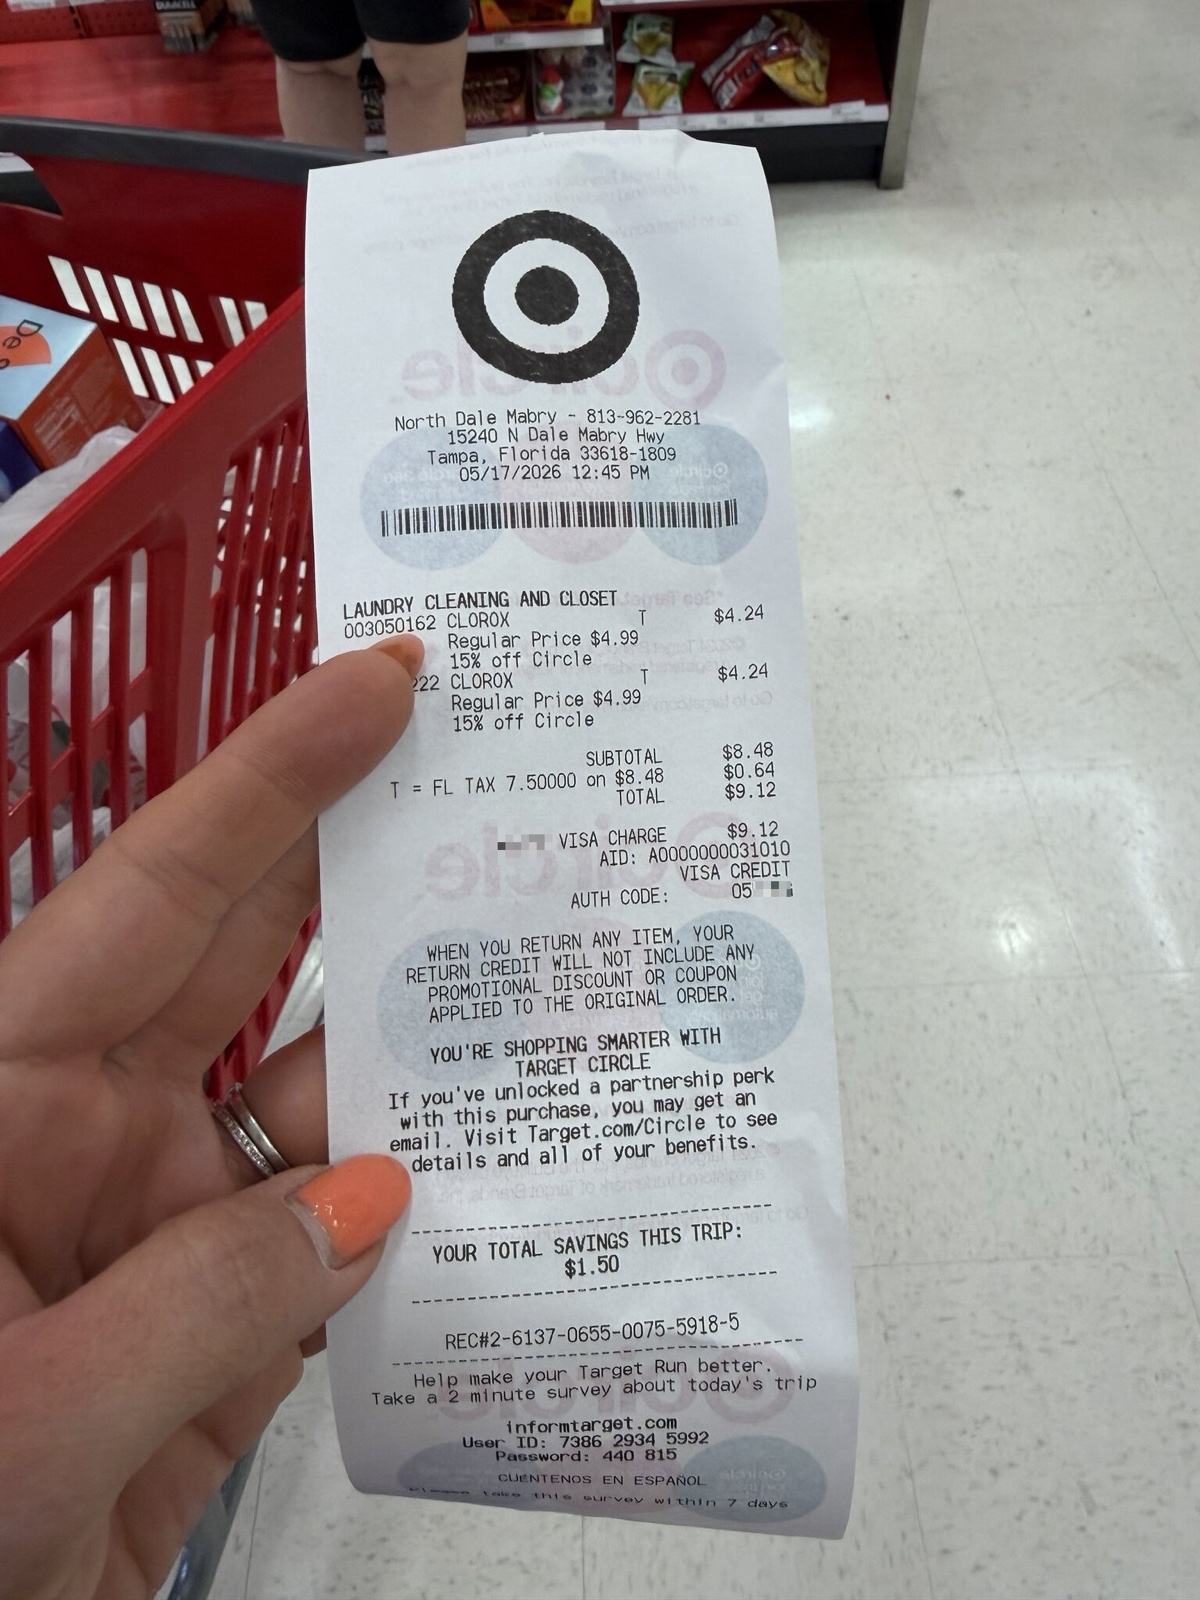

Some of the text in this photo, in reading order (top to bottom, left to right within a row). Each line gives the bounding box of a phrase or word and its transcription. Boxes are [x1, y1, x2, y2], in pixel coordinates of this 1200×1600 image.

[394, 408, 701, 432] North Dale Mabry 813-962-2281
[447, 425, 665, 446] 15240 N Dale Mabry Hwy
[427, 444, 677, 466] Tampa, Florida 33618-1809
[459, 463, 562, 483] 05/17/2026
[571, 463, 621, 480] 12:45
[629, 464, 650, 481] PM
[343, 589, 618, 621] LAUNDRY CLEANING AND CLOSET
[344, 603, 764, 640] 003050162 CLOROX T $4.24
[447, 629, 639, 652] Regular Price $4.99
[449, 652, 481, 670] 15%
[491, 651, 522, 669] off
[532, 649, 592, 668] Circle
[450, 671, 514, 691] CLOROX
[640, 668, 649, 685] T
[717, 662, 768, 684] $4.24
[451, 688, 642, 714] Regular Price $4.99
[453, 710, 595, 733] 15% off Circle
[585, 741, 774, 767] SUBTOTAL $8.48
[390, 761, 775, 799] T FL TAX 7.50000 on $8.48 $0.64
[615, 780, 777, 807] TOTAL $9.12
[558, 830, 599, 850] VISA
[608, 826, 668, 846] CHARGE
[726, 820, 779, 841] $9.12
[599, 839, 791, 868] AID: A0000000031010
[679, 859, 791, 882] VISA CREDIT
[570, 886, 668, 910] AUTH CODE:
[426, 923, 735, 963] WHEN YOU RETURN ANY ITEM, YOUR
[406, 943, 755, 985] RETURN CREDIT WILL NOT INCLUDE ANY
[428, 964, 737, 1003] PROMOTIONAL DISCOUNT OR COUPON
[429, 985, 735, 1024] APPLIED TO THE ORIGINAL ORDER.
[429, 1026, 721, 1065] YOU'RE SHOPPING SMARTER WITH
[514, 1052, 652, 1079] TARGET CIRCLE
[388, 1066, 775, 1111] If you've unlocked a partnership perk
[400, 1091, 756, 1131] with this purchase, you may get an
[389, 1112, 778, 1153] email. Visit Target.com/Circle to see
[411, 1133, 756, 1173] details and all of your benefits.
[432, 1221, 742, 1265] YOUR TOTAL SAVINGS THIS TRIP:
[564, 1254, 620, 1280] $1.50
[445, 1311, 741, 1350] REC#2-6137-0655-0075-5918-5
[413, 1357, 771, 1389] Help make your Target Run better.
[371, 1374, 817, 1406] Take a 2 minute survey about today's trip
[462, 1430, 710, 1449] User ID: 7386 2934 5992
[506, 1416, 678, 1435] informtarget.com
[495, 1447, 677, 1462] Password: 440 815
[602, 1475, 624, 1485] EN
[634, 1475, 701, 1486] ESPAÑOL
[729, 1498, 737, 1507] 7
[747, 1499, 788, 1509] days
